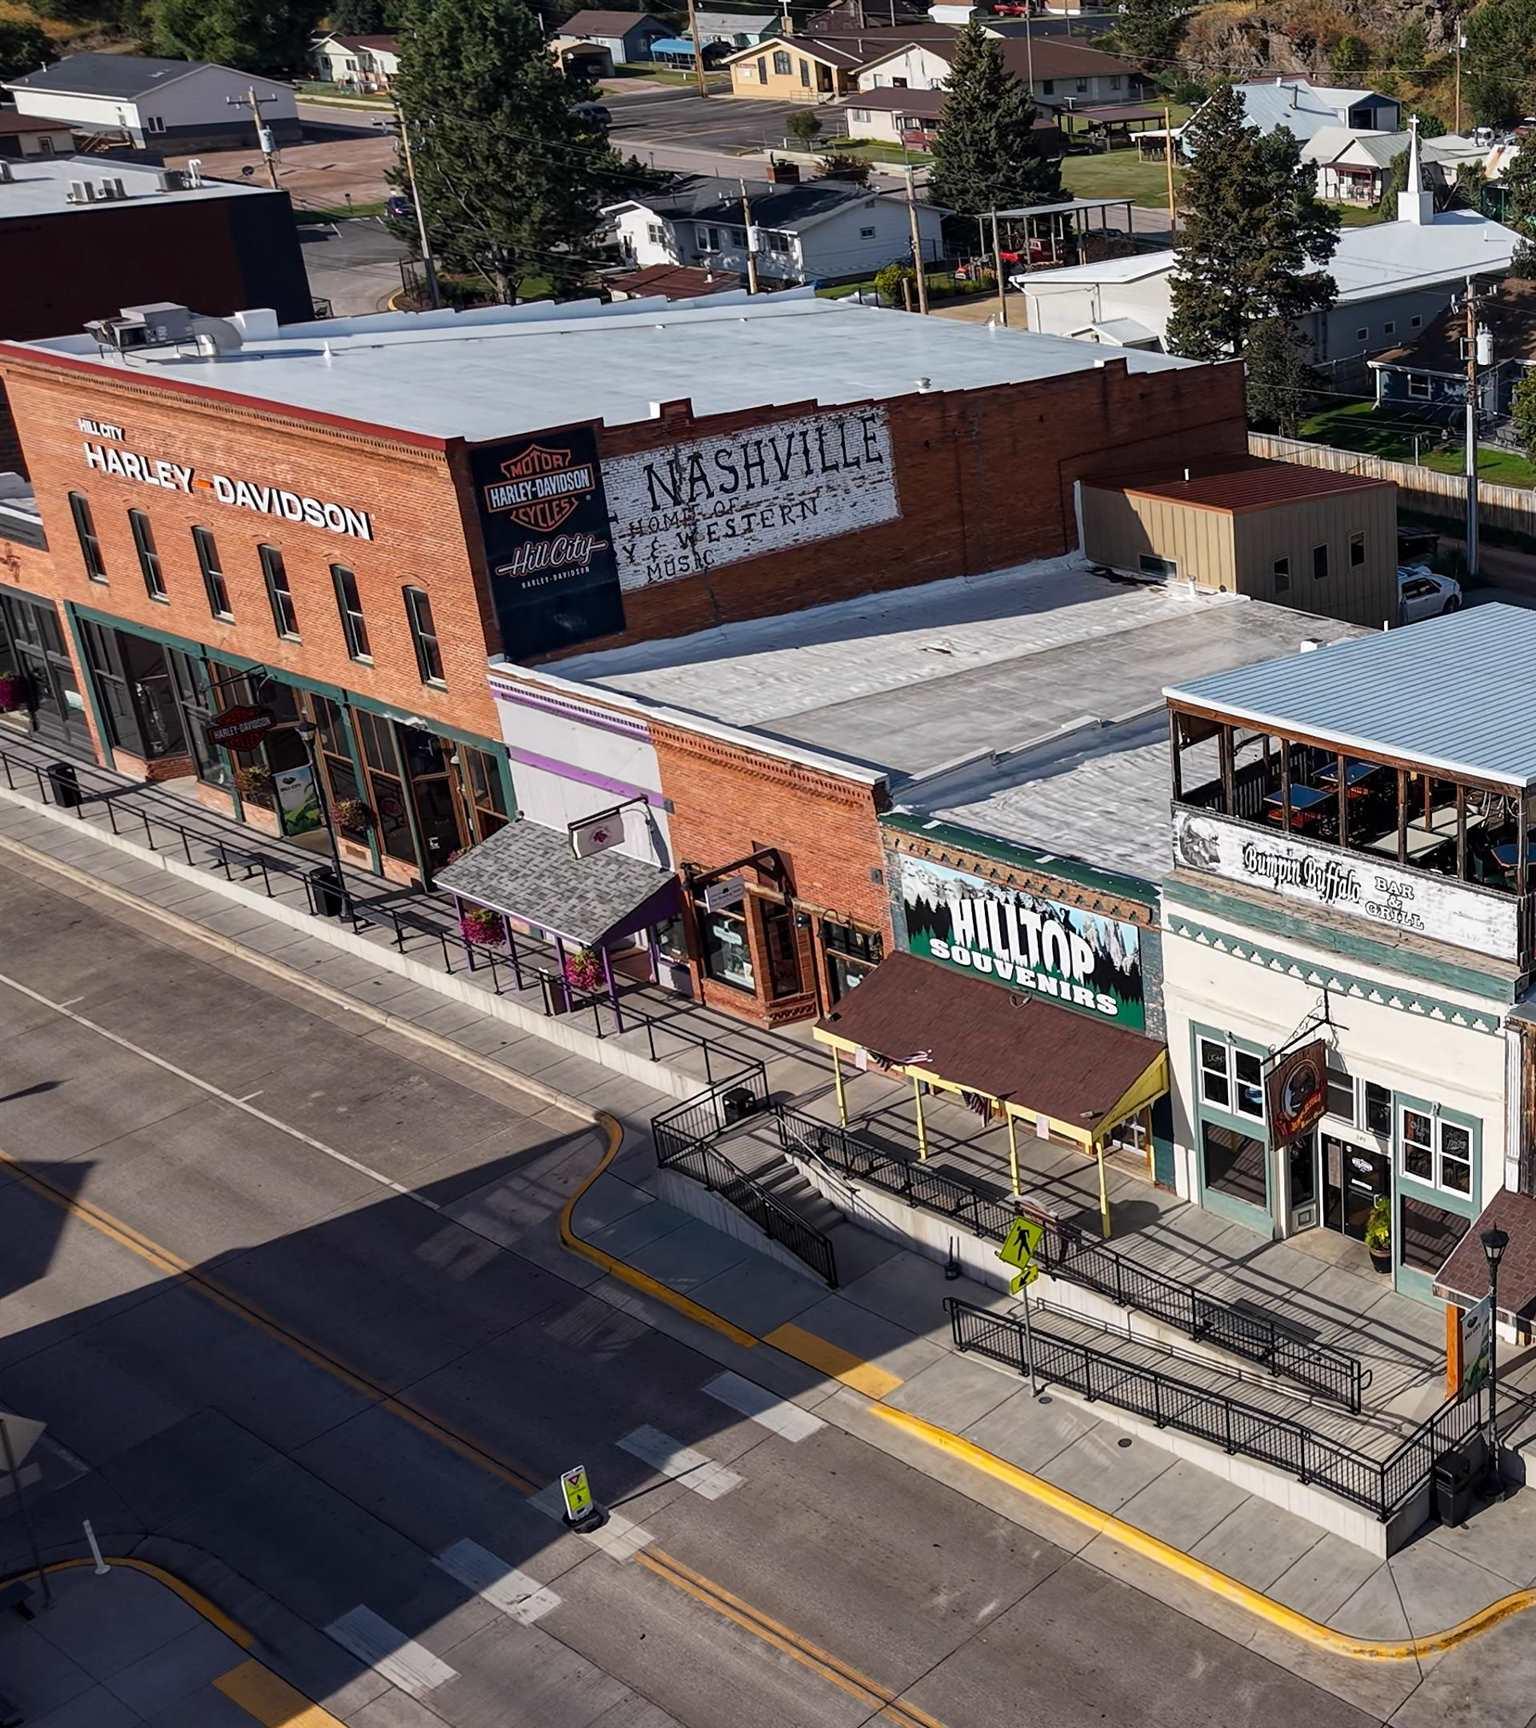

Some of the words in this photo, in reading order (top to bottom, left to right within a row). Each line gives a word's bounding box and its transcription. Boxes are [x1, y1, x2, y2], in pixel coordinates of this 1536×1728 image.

[77, 417, 101, 437] HILL
[100, 422, 125, 441] CITY
[510, 450, 564, 478] MOTOR
[642, 413, 884, 512] NASHVILLE
[490, 468, 590, 508] HARLEY-DAVIDSON
[518, 498, 570, 527] CYCLES
[676, 496, 821, 550] WESTERN
[498, 541, 549, 575] Hill
[550, 534, 607, 564] City
[521, 566, 590, 589] HARLEY-DAVIDSON
[1242, 842, 1301, 891] Bumpin
[1301, 854, 1362, 905] Buffalo
[1374, 875, 1415, 900] BAR
[1365, 901, 1425, 930] GRILL
[1387, 894, 1402, 909] &
[949, 898, 1096, 986] HILLTOP
[929, 938, 1119, 1016] SOUVENIRS
